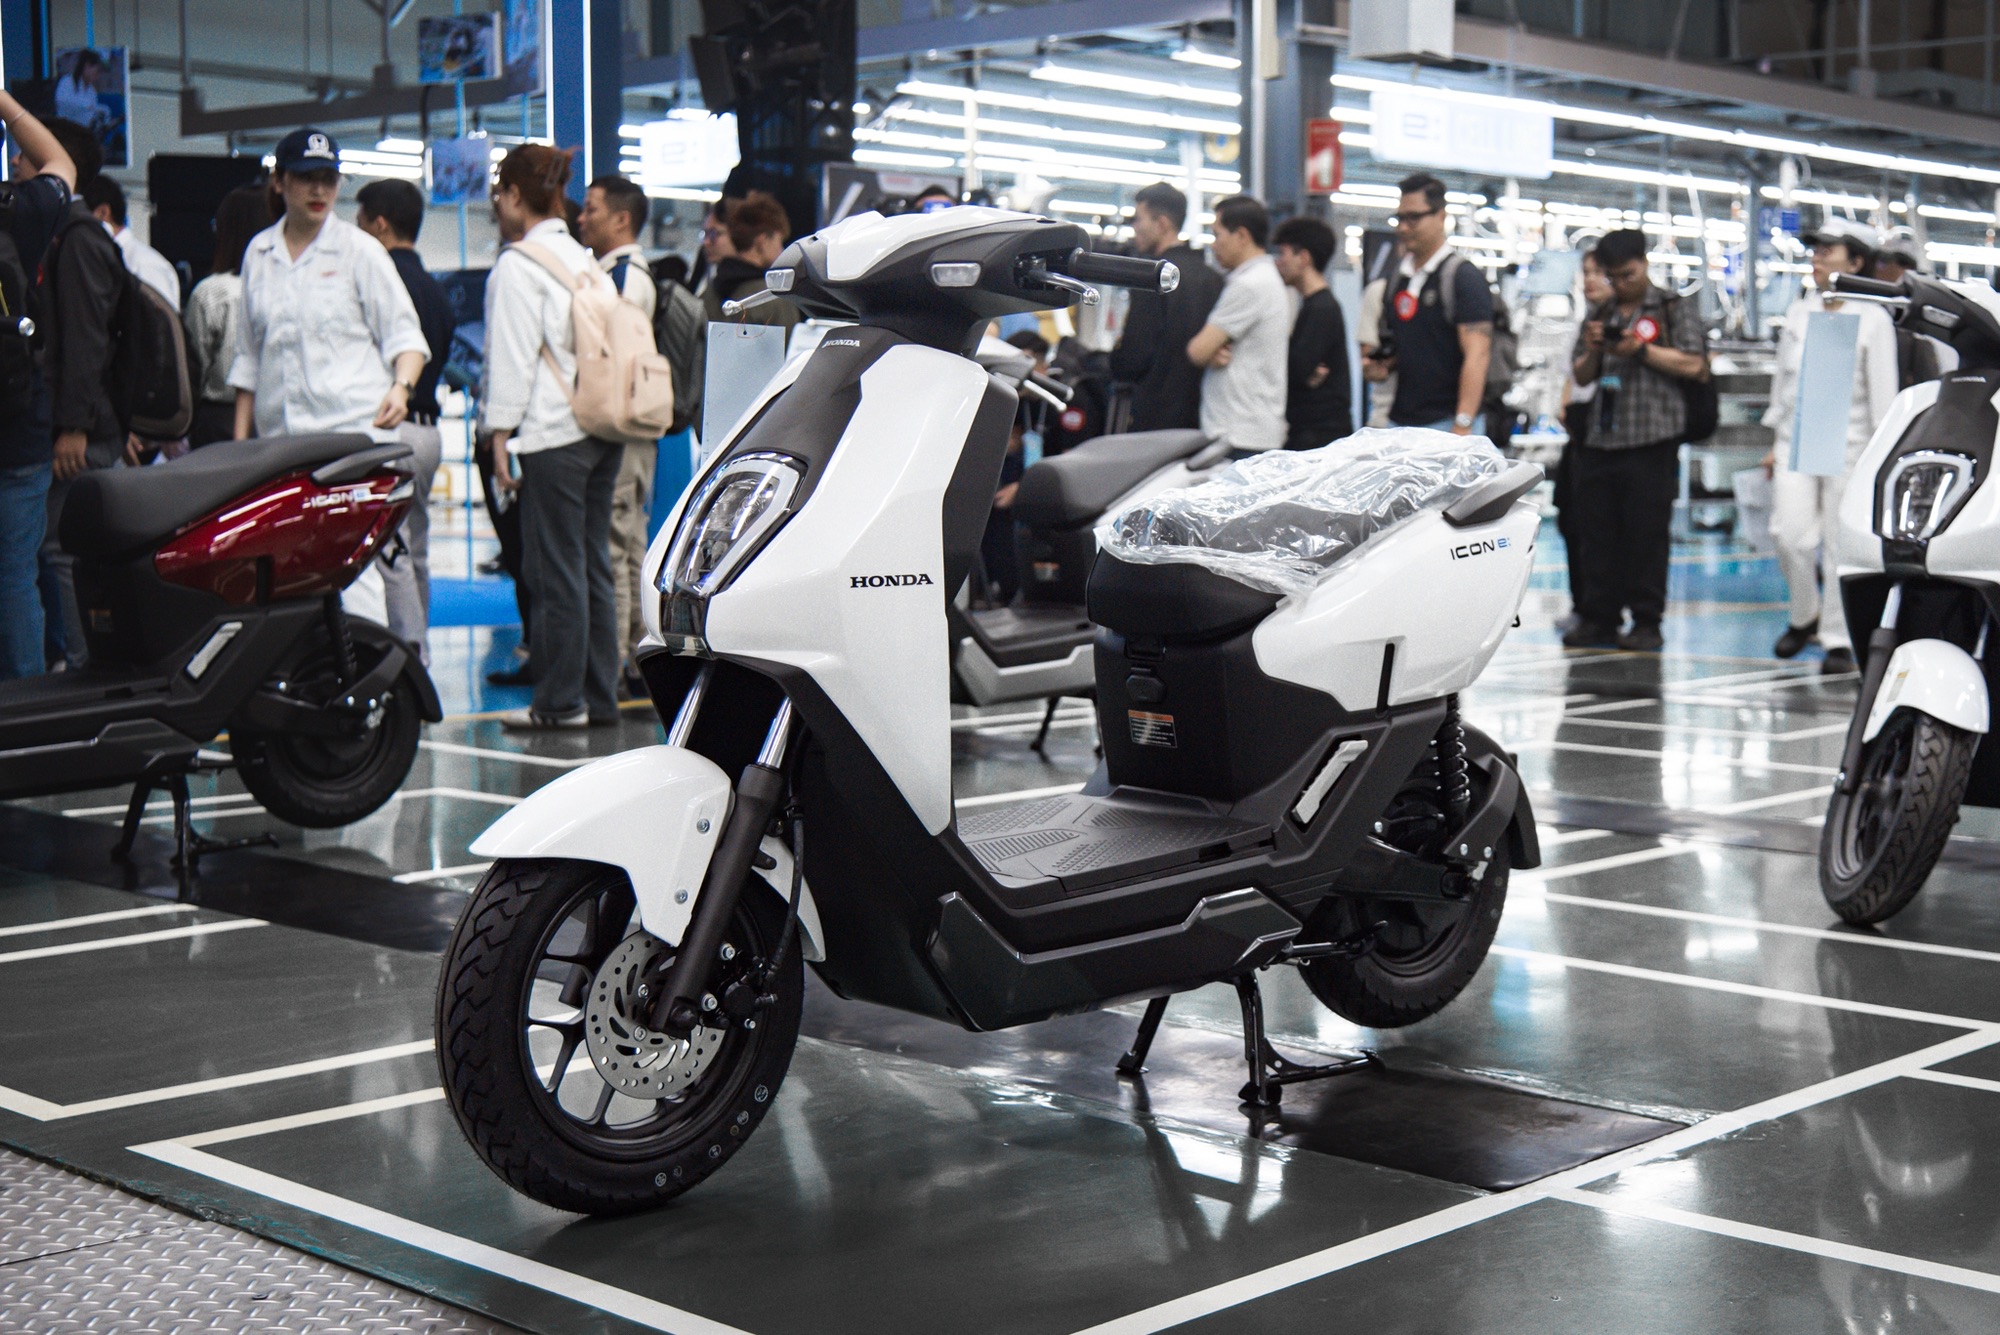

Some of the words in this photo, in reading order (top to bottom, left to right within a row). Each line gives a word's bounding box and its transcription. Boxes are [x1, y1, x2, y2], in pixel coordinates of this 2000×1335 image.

[821, 339, 861, 348] HONDA
[1450, 539, 1495, 560] ICON
[850, 573, 934, 588] HONDA
